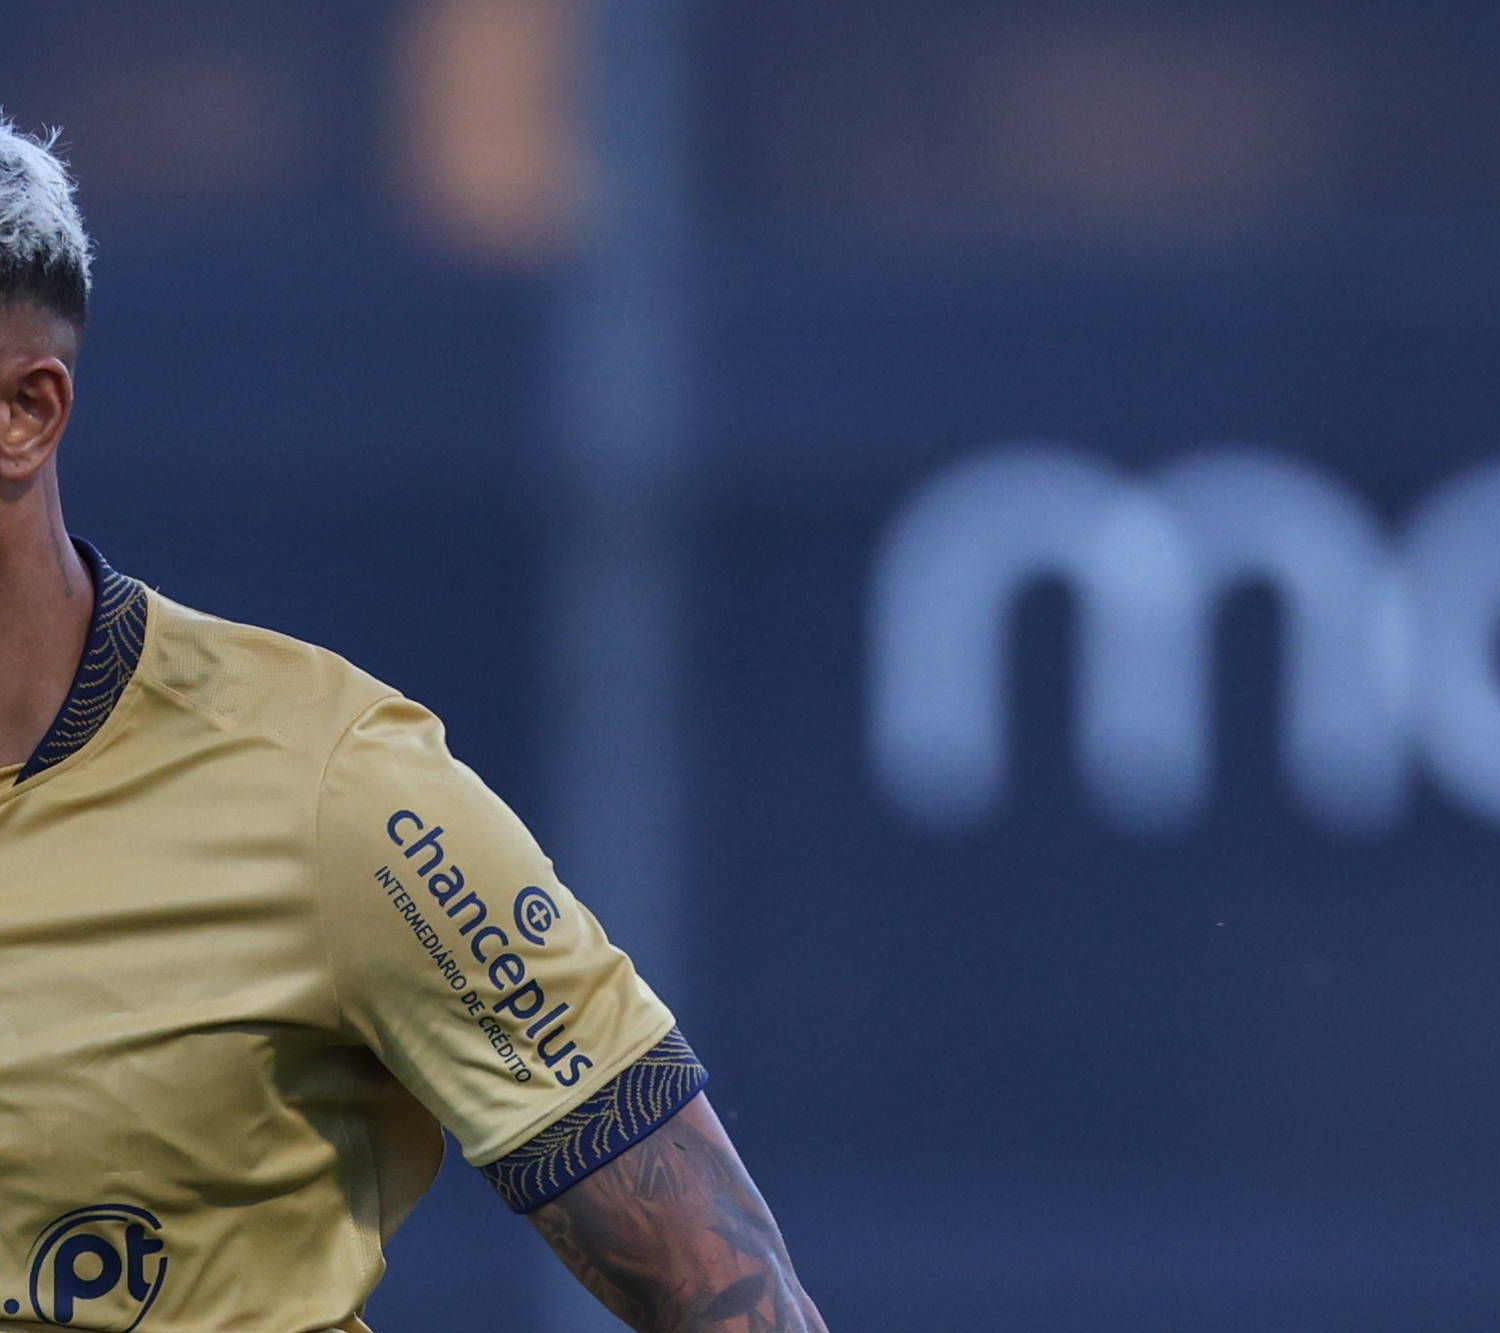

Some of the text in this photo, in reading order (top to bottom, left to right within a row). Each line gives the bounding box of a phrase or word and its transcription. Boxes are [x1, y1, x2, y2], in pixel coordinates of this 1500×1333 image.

[374, 865, 532, 1084] INTERMEDIÁRIO DE CRÉDITO
[387, 809, 593, 1087] chanceplus
